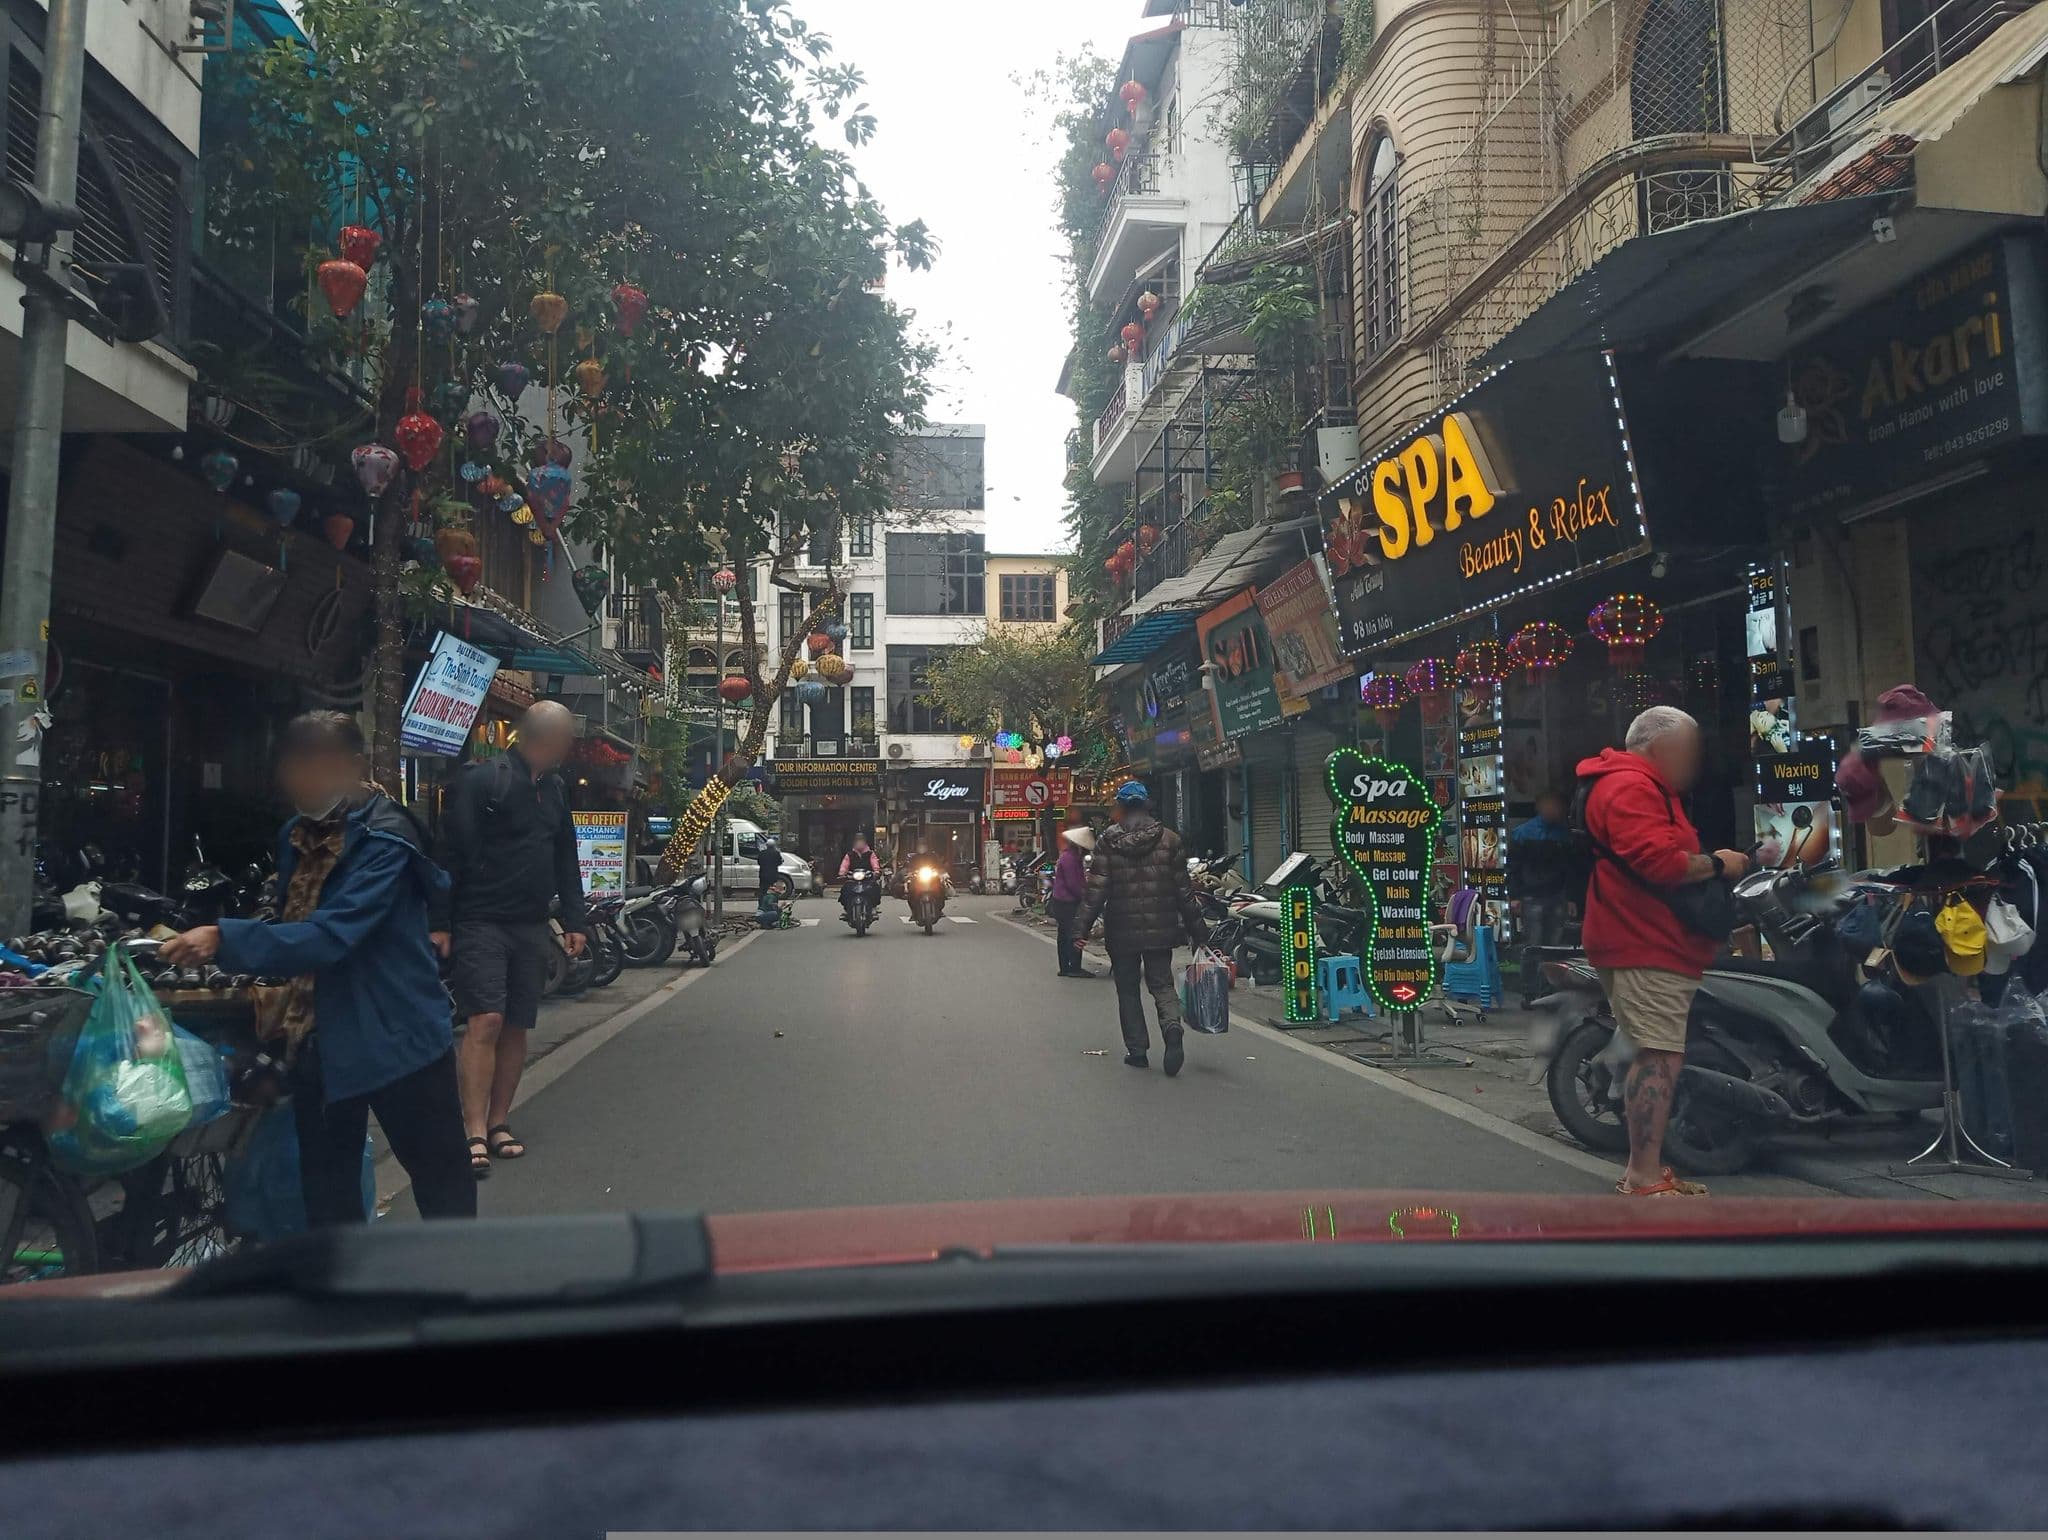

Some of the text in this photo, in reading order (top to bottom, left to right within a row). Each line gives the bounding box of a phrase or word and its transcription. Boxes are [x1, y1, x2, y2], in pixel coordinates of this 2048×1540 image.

[1860, 290, 2002, 419] Akari
[1868, 370, 2004, 444] from Hanoi with love
[1372, 411, 1507, 561] SPA
[1459, 478, 1618, 579] Beauty & Relex
[1353, 621, 1366, 640] 98
[442, 656, 457, 680] The
[455, 662, 472, 686] Sinh
[412, 687, 455, 723] BOOKING
[447, 699, 479, 729] OFFICE
[775, 762, 878, 773] TOUR INFORMATION CENTER
[1773, 761, 1819, 784] Waxing
[832, 776, 853, 786] HOTEL
[1350, 774, 1408, 803] Spa
[592, 814, 624, 826] OFFICE
[1350, 805, 1430, 830] Massage
[1345, 831, 1406, 849] Body Massage
[1354, 848, 1407, 864] Foot Massage
[1372, 868, 1420, 881] Gel color
[1386, 886, 1410, 900] Nails
[1381, 906, 1421, 922] Waxing
[1377, 926, 1394, 940] Take
[1408, 925, 1424, 940] skin
[1294, 901, 1310, 1009] FOOT
[1373, 947, 1429, 962] Eyelash Extensions
